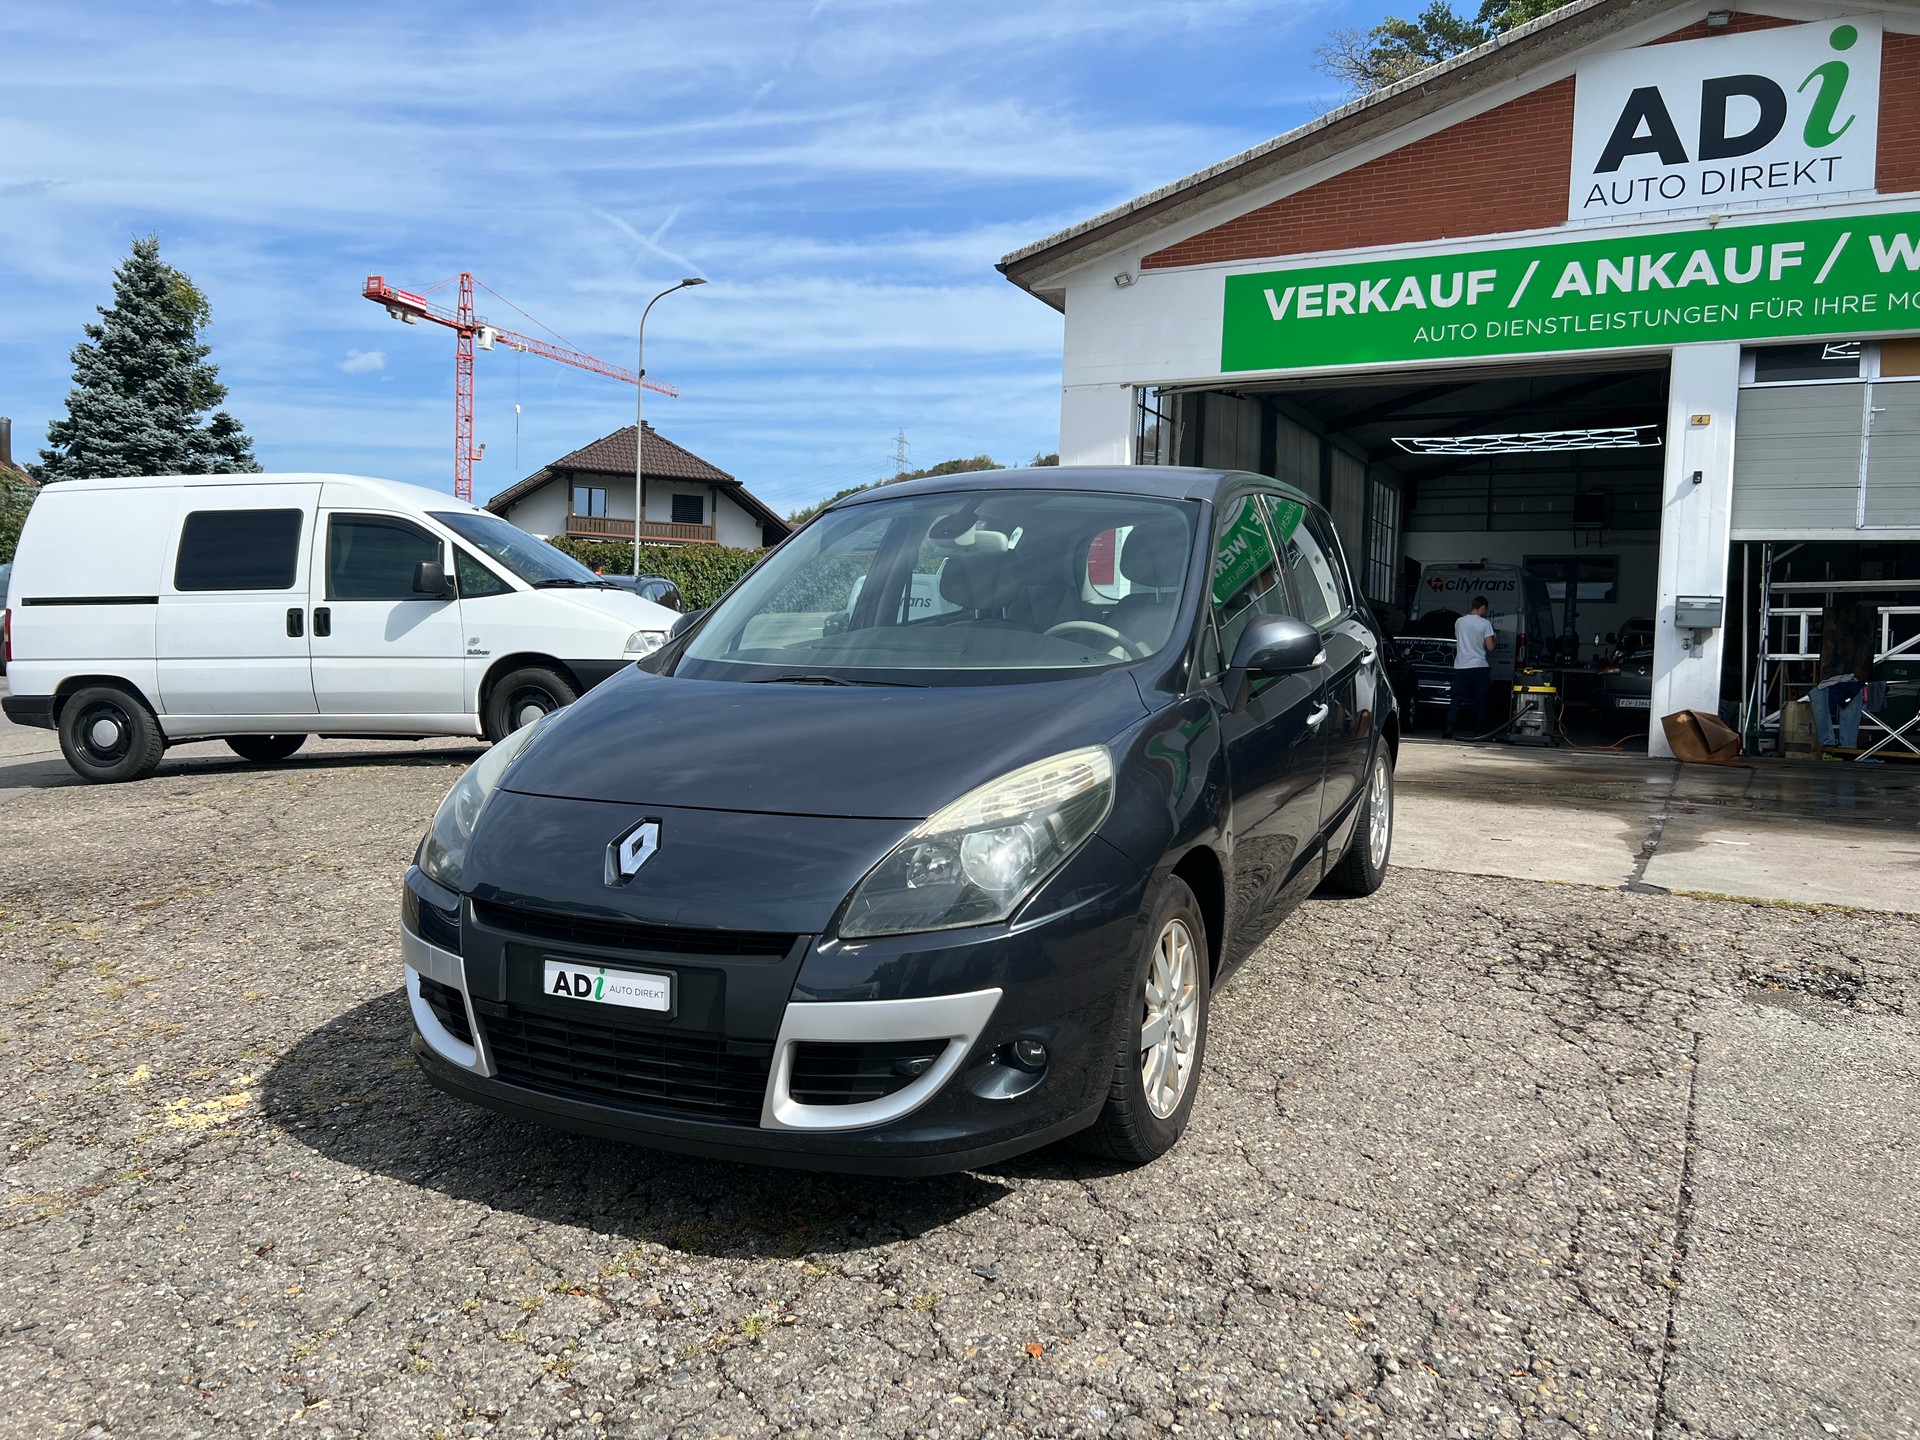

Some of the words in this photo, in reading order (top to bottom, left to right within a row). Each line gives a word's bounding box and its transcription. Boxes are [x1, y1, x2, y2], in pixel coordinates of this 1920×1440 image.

[1592, 24, 1856, 175] ADi
[1583, 174, 1687, 209] AUTO
[1701, 156, 1843, 196] DIREKT
[1263, 268, 1497, 321] VERKAUF
[1551, 241, 1805, 299] ANKAUF
[1412, 323, 1478, 344] AUTO
[1486, 303, 1739, 339] DIENSTLEISTUNGEN
[1749, 297, 1804, 320] FÜR
[1814, 293, 1878, 316] IHRE
[1444, 577, 1516, 593] citytrans
[552, 967, 606, 1001] ADi
[609, 985, 633, 996] AUTO
[634, 987, 665, 999] DIREKT
